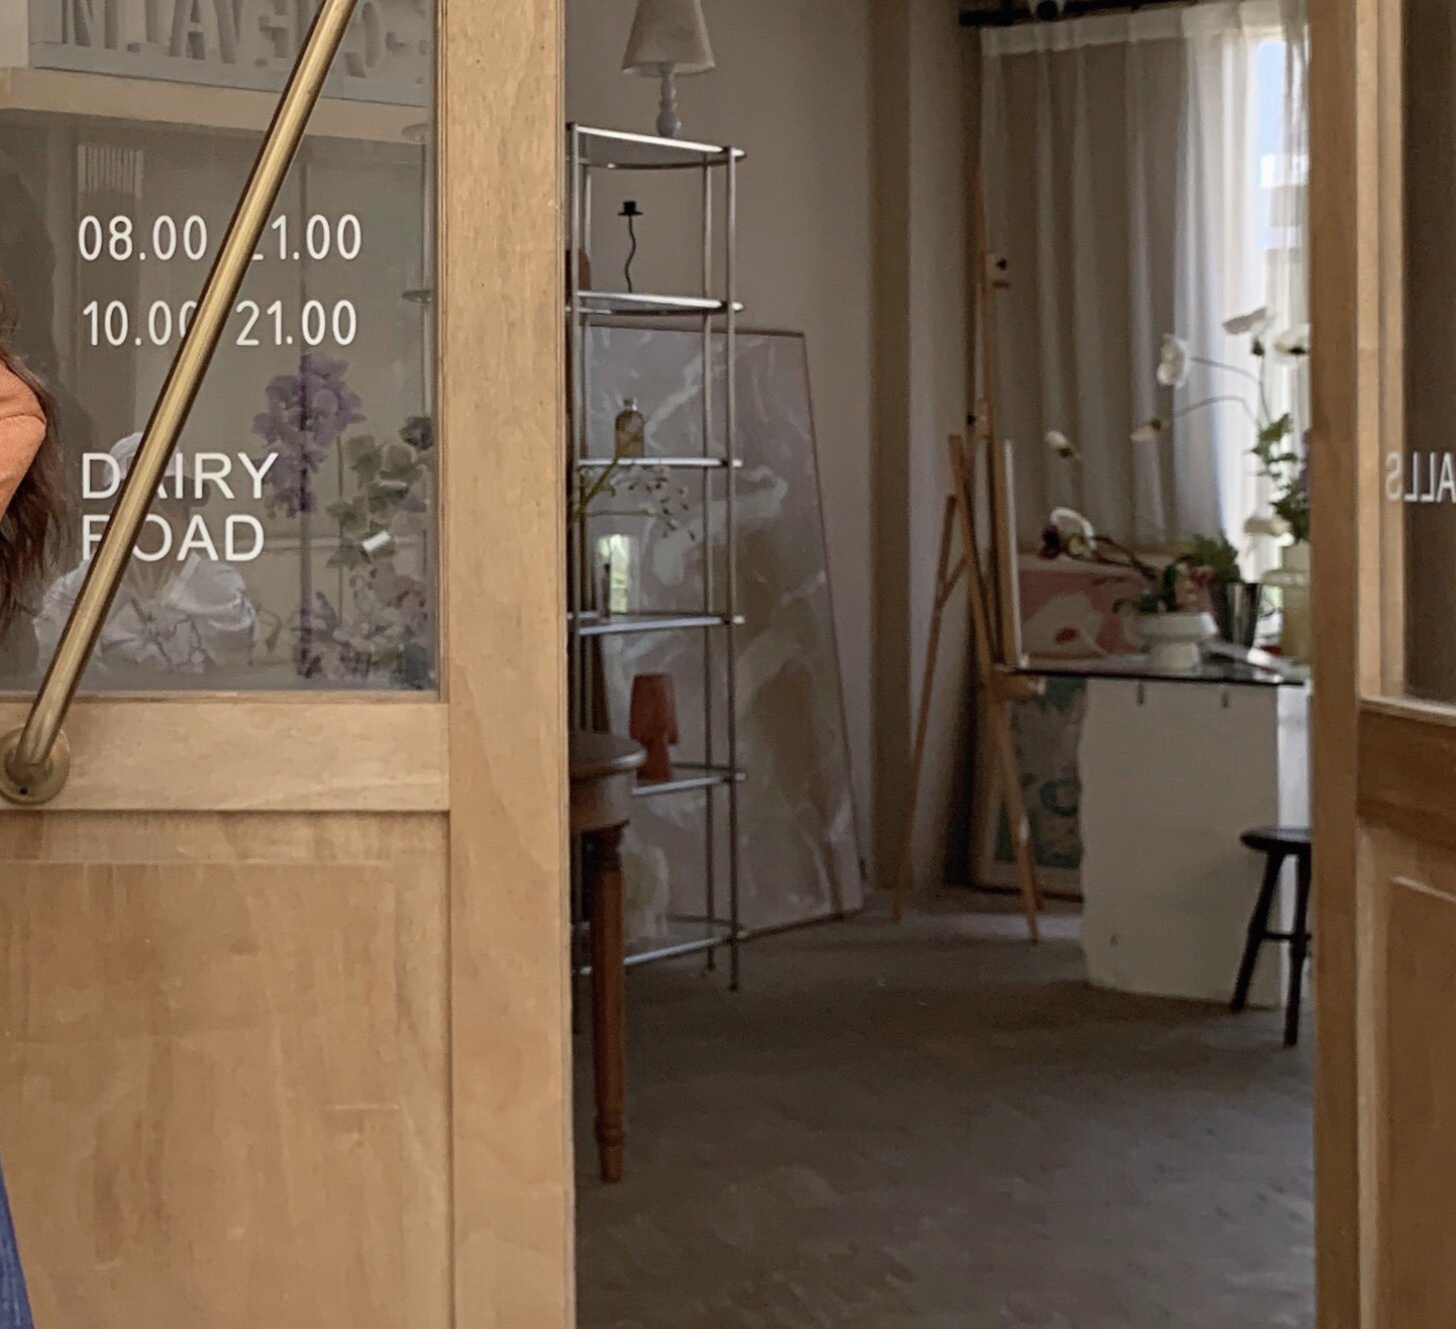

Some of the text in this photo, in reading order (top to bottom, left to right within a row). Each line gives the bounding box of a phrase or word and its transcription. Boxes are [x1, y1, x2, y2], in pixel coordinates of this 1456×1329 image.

[77, 213, 363, 261] 08.00 1.00
[235, 299, 358, 347] 21.00
[81, 451, 280, 500] DIRY
